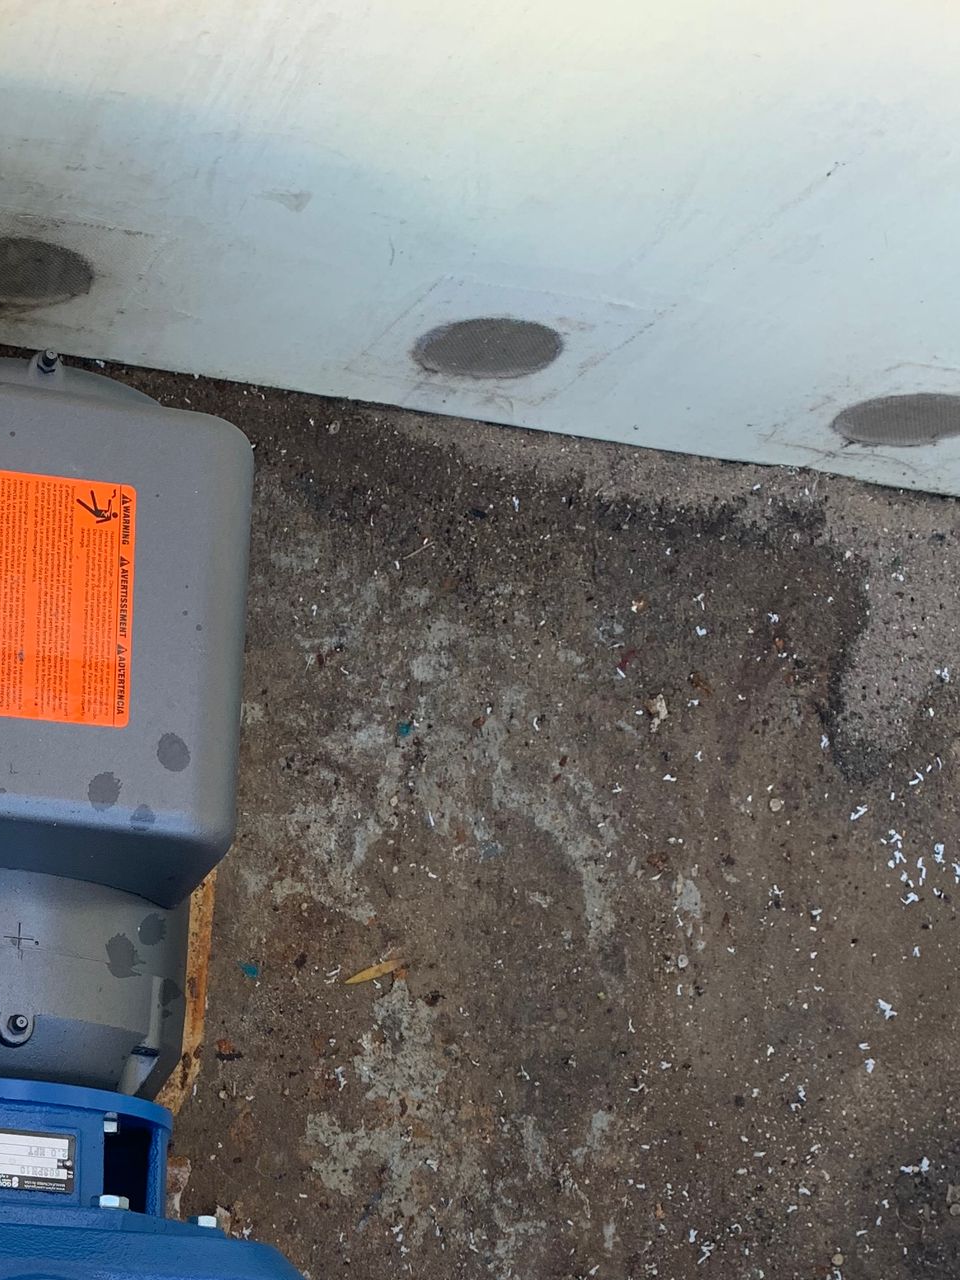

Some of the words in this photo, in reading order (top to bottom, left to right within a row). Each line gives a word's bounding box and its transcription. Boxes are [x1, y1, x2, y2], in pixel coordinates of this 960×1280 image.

[121, 505, 130, 545] WARNING
[119, 568, 128, 638] AVERTISSEMENT
[116, 655, 125, 715] ADVERTENCIA
